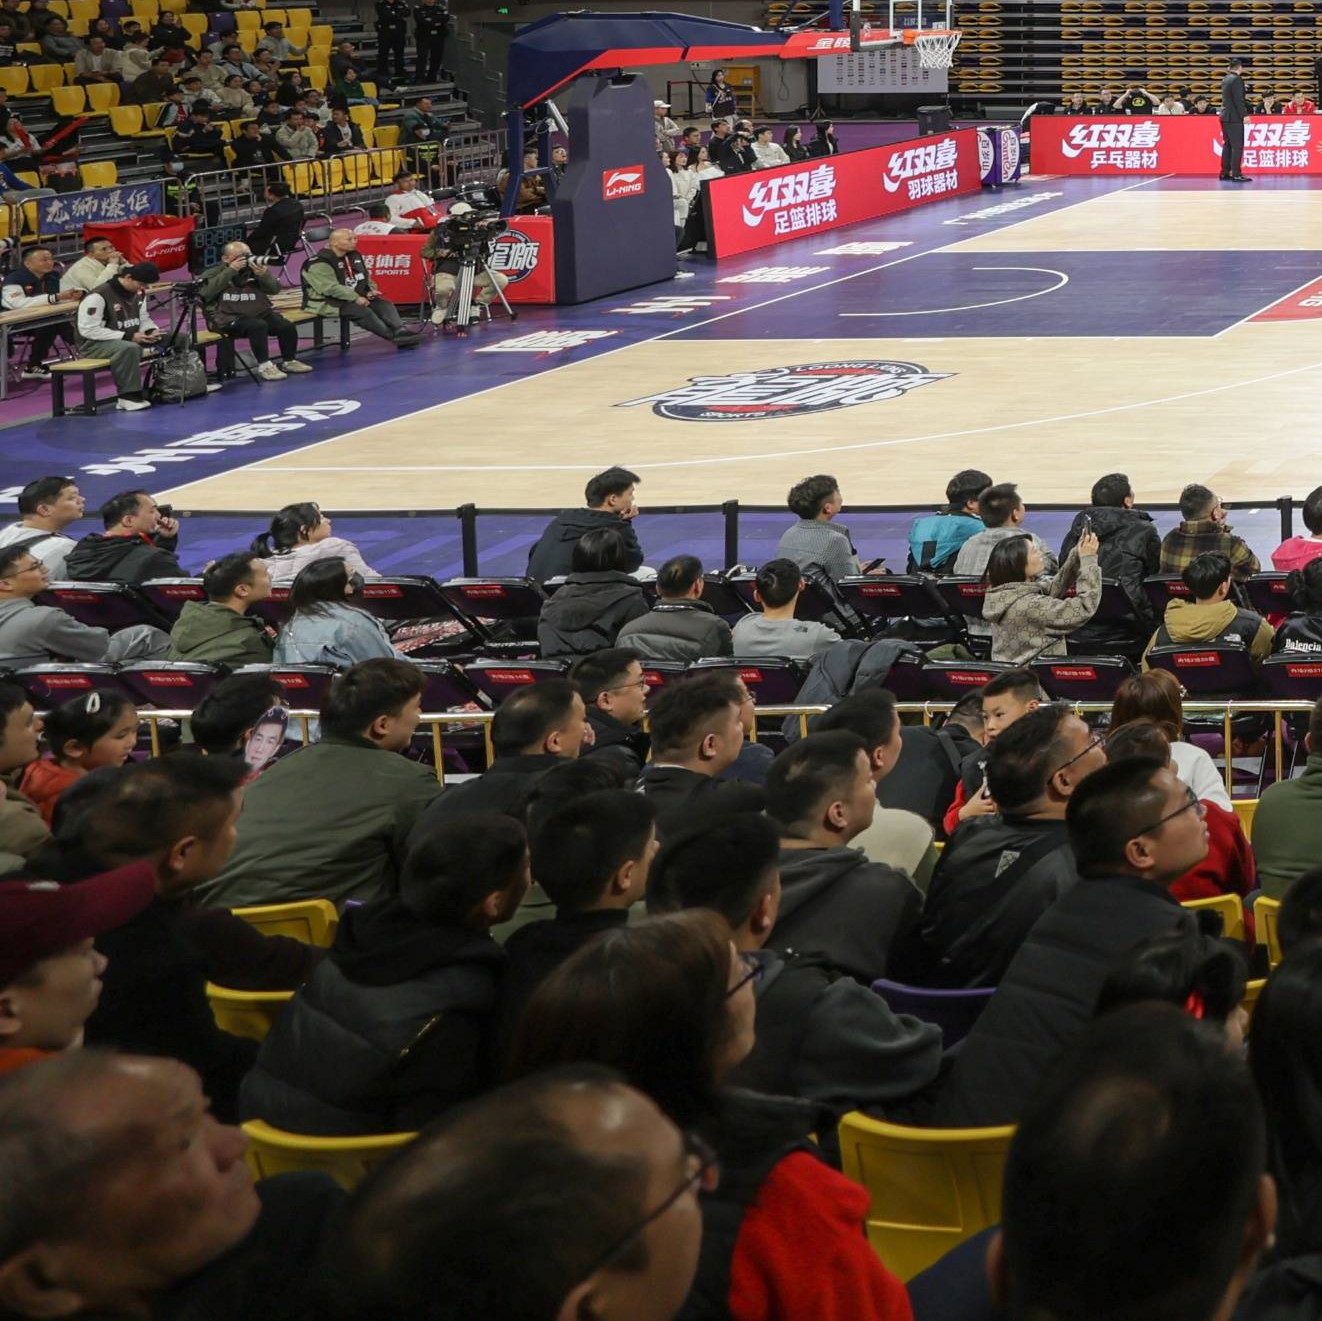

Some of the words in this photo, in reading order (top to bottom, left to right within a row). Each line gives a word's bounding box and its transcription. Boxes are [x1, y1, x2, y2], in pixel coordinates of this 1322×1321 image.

[1062, 121, 1161, 157] 红双喜
[883, 137, 959, 192] 红双喜
[1090, 151, 1158, 169] 乒乓器材
[1242, 149, 1310, 168] 足篮排球
[606, 182, 642, 196] LI-NING
[742, 164, 837, 226] 红双喜
[907, 170, 959, 201] 羽球器材
[46, 189, 151, 224] 龙狮爆佢
[774, 199, 838, 236] 足篮排球
[145, 244, 186, 257] LI-NING
[700, 409, 767, 418] SPORTS
[40, 399, 362, 486] 州南沙
